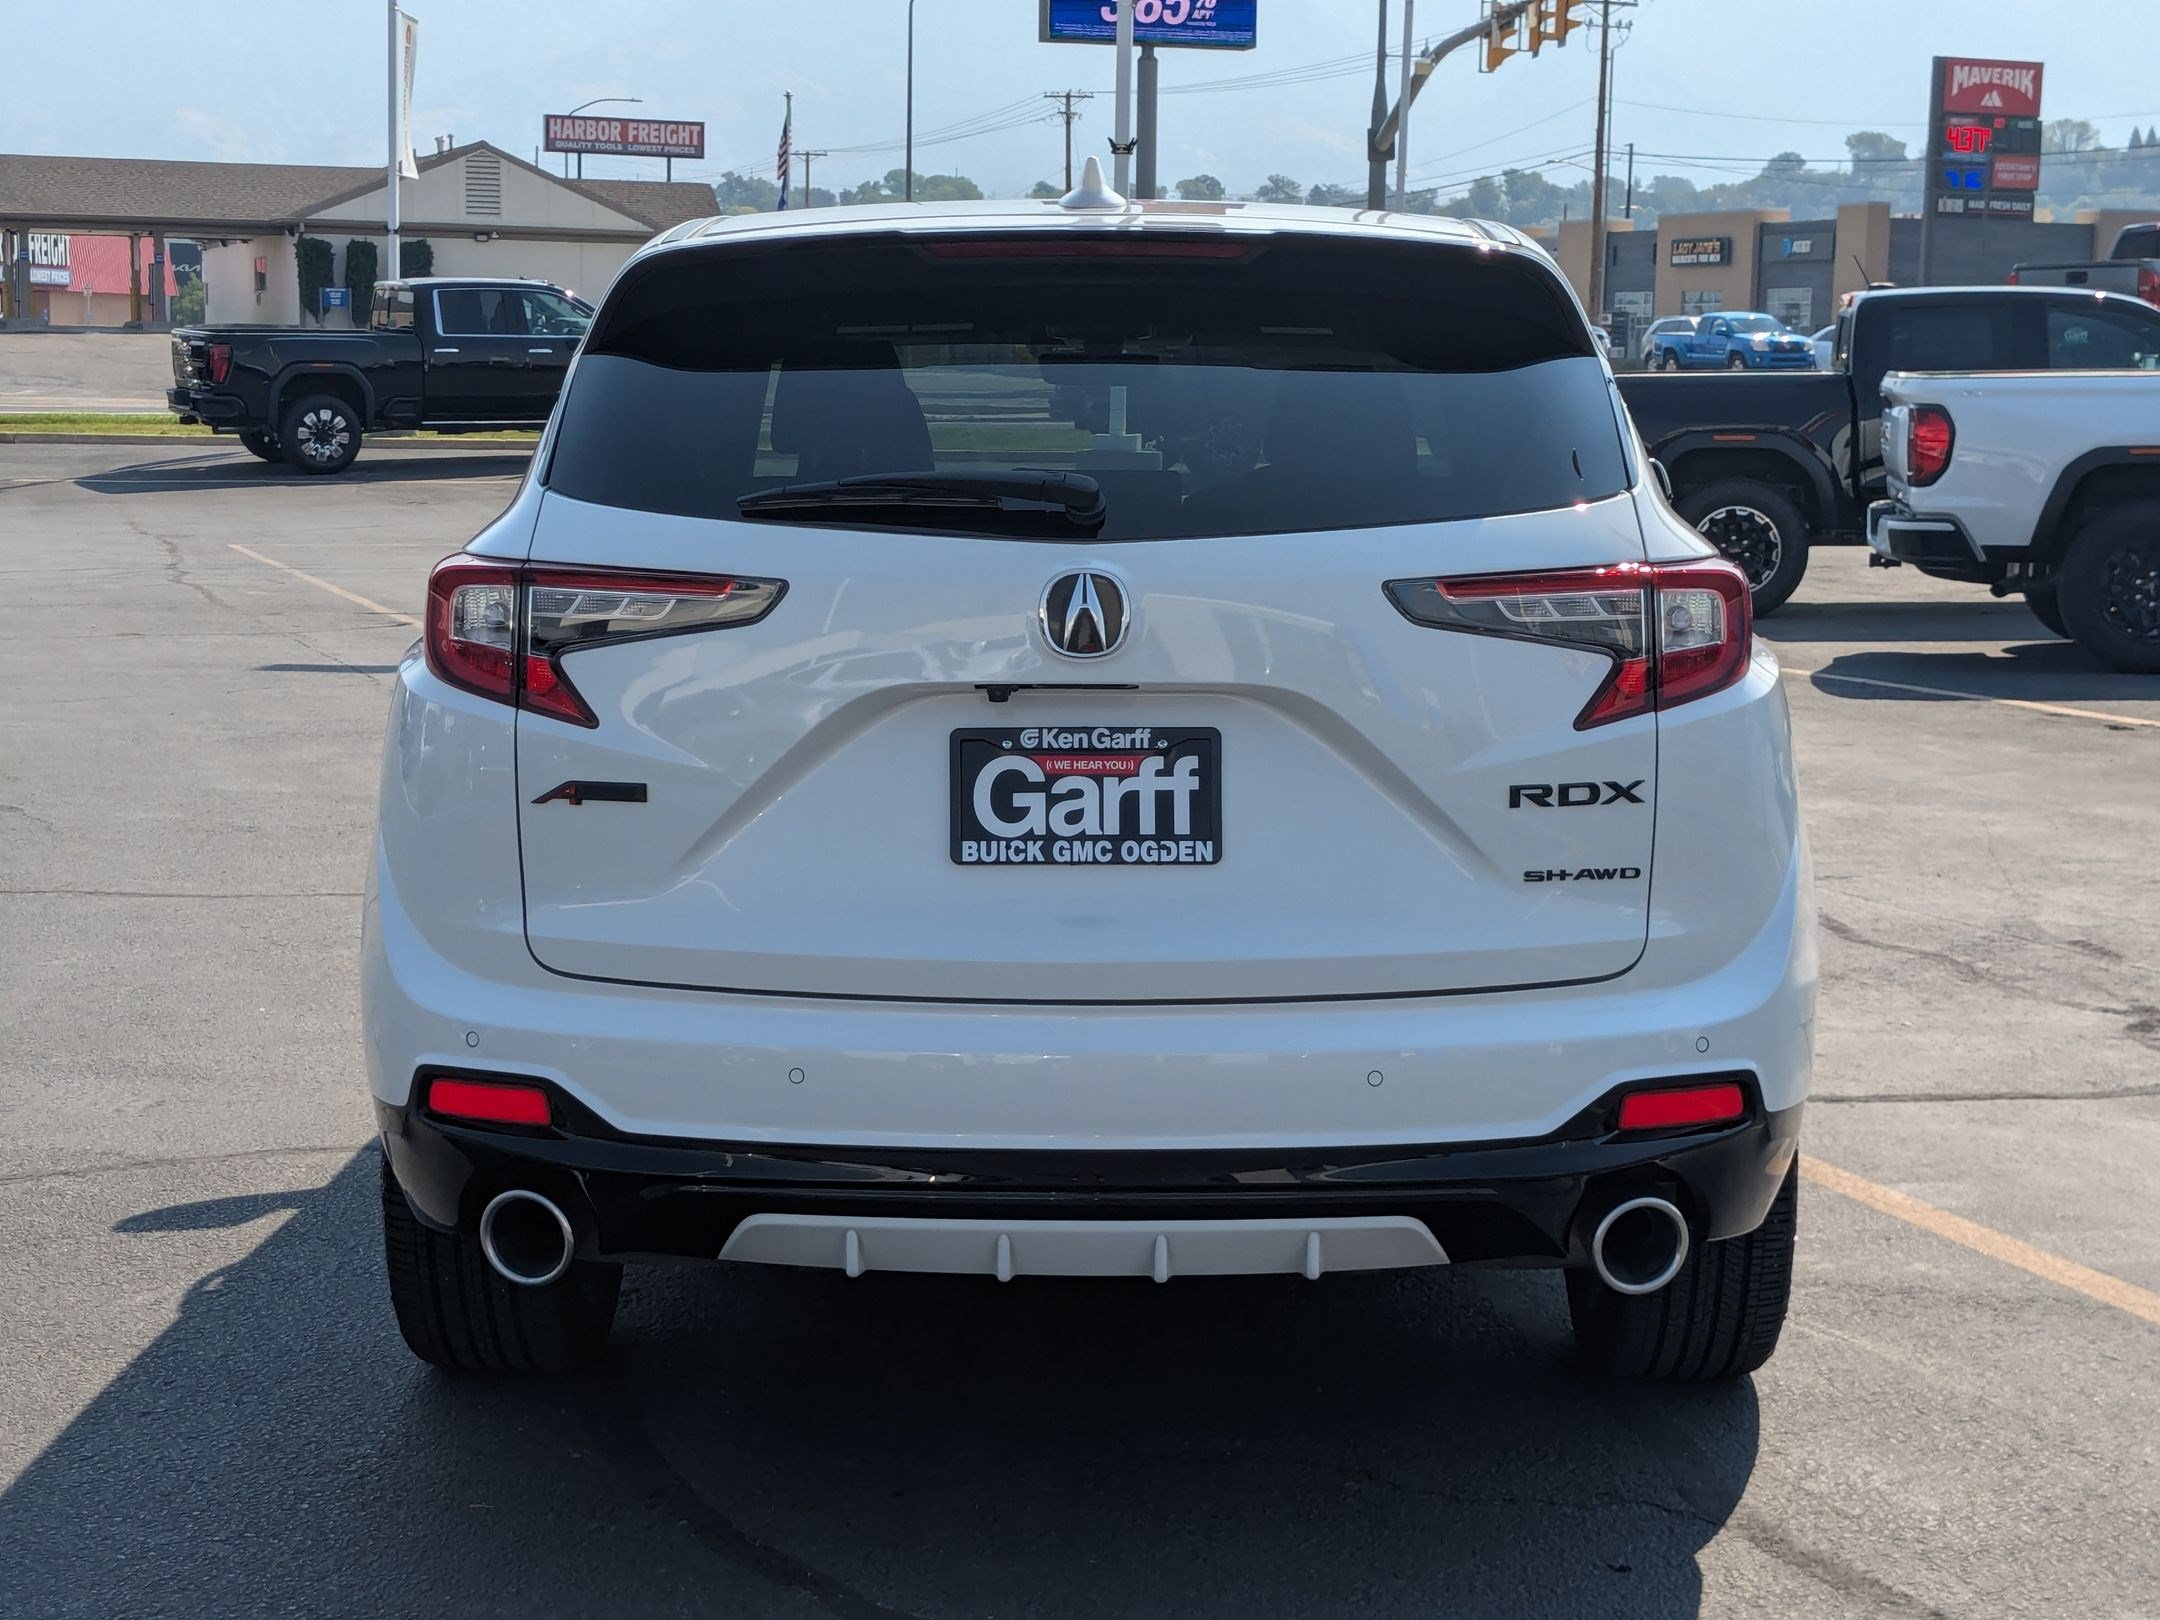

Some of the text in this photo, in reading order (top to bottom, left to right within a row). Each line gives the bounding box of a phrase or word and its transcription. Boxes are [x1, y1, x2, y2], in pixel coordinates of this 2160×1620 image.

[1951, 64, 2036, 101] MAVERIK
[550, 117, 701, 147] HARBOR FREIGHT
[555, 140, 696, 154] QUALITY TOOLS LOWEST PRICES
[28, 233, 71, 266] FREIGHT
[1042, 727, 1151, 749] Ken Garff
[1053, 760, 1127, 770] WE HEAR YOU
[973, 755, 1200, 838] Garff
[1508, 779, 1646, 809] RDX
[962, 840, 1213, 863] BUICK GMC OGDEN
[1523, 867, 1641, 882] SH-AWD
